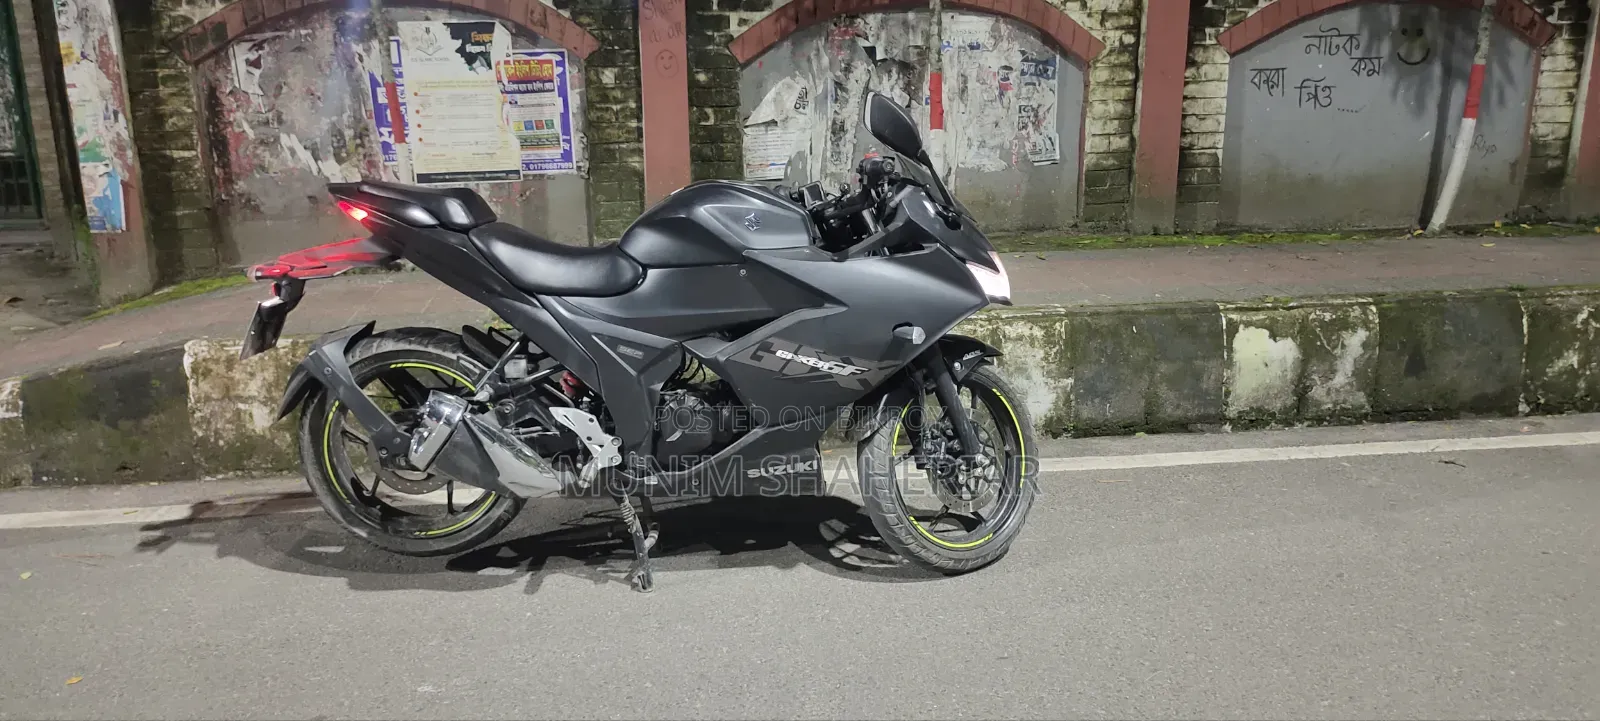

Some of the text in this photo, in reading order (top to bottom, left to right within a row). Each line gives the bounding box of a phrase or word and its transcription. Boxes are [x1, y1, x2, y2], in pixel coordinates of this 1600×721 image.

[1303, 25, 1360, 56] নাটক
[1350, 56, 1383, 77] কম
[747, 460, 818, 478] SUZUKI
